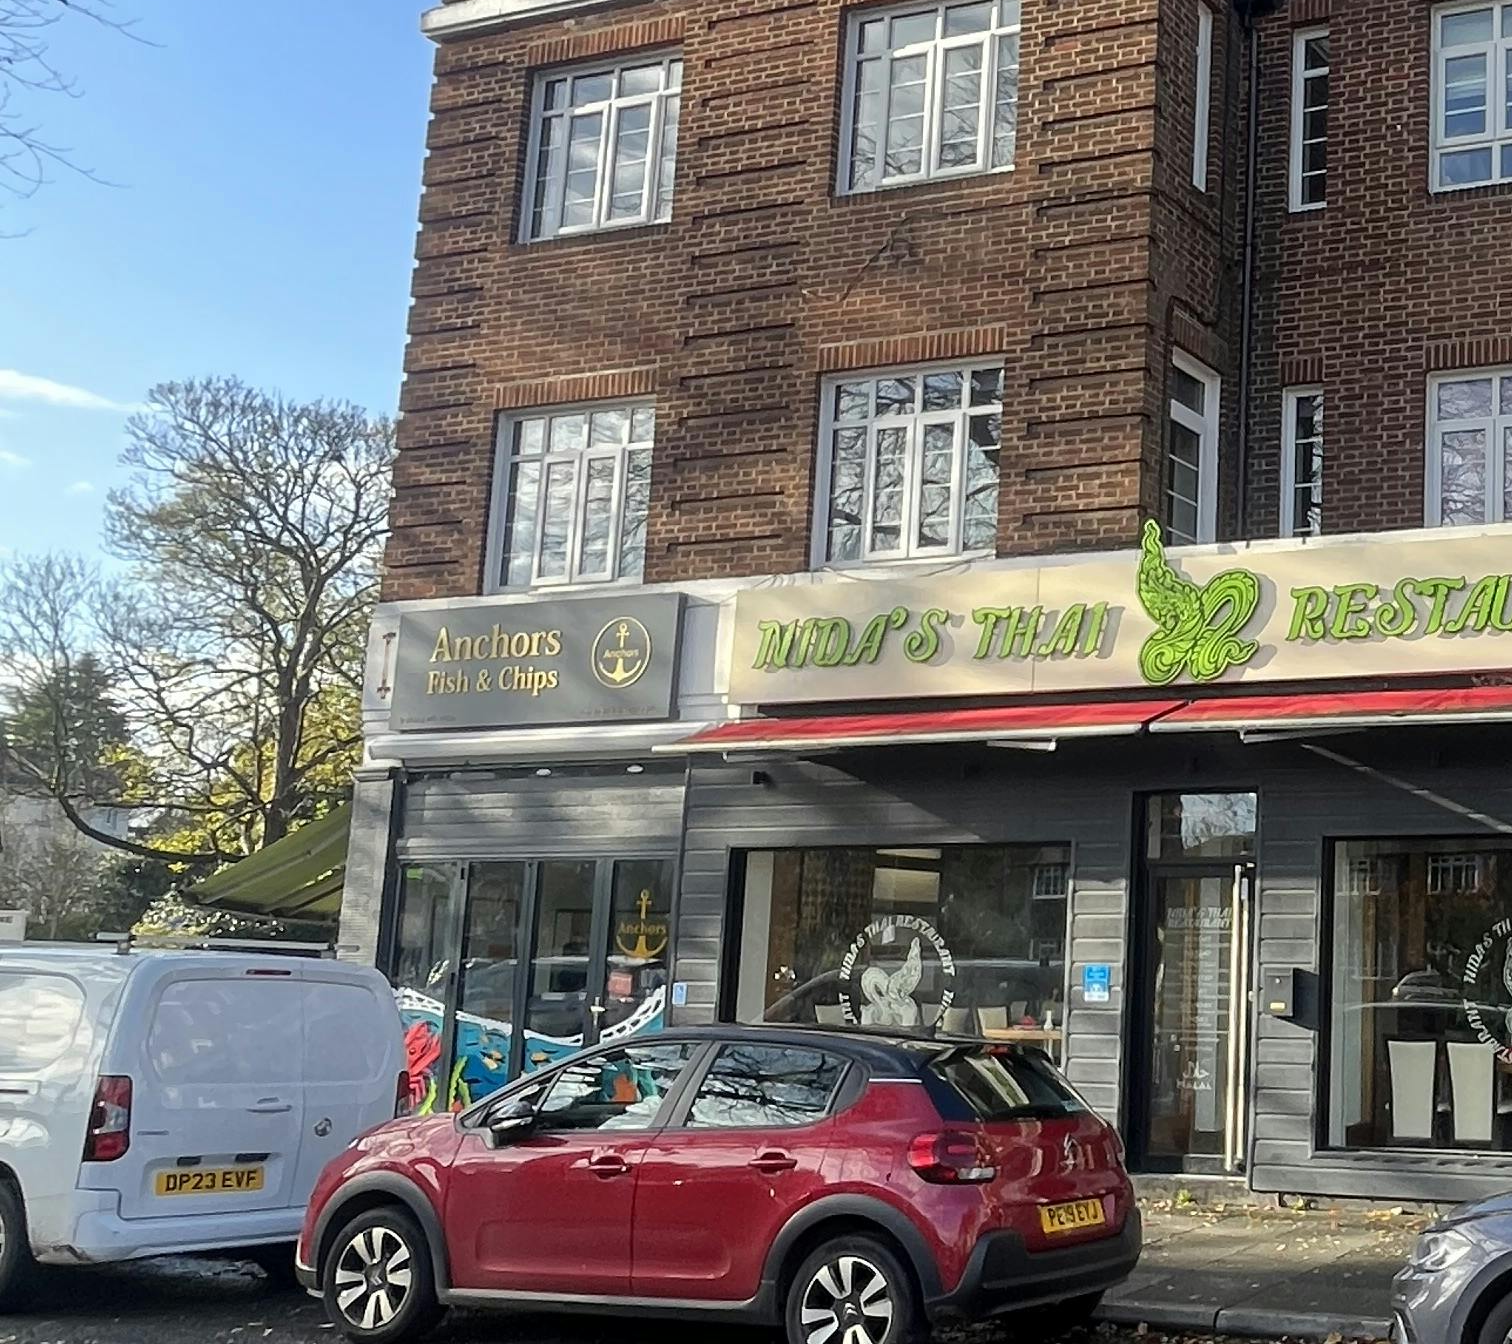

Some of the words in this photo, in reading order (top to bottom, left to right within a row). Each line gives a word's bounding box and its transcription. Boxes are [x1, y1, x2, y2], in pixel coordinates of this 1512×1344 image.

[429, 623, 562, 663] Anchors
[751, 605, 949, 669] NIDA'S
[972, 601, 1108, 660] THAI
[426, 668, 469, 695] Fish
[476, 668, 492, 692] &
[498, 665, 559, 697] Chips
[620, 920, 667, 935] Anchors
[895, 915, 956, 976] RESTAURANT
[165, 1172, 217, 1192] DP23
[221, 1169, 258, 1188] EVF
